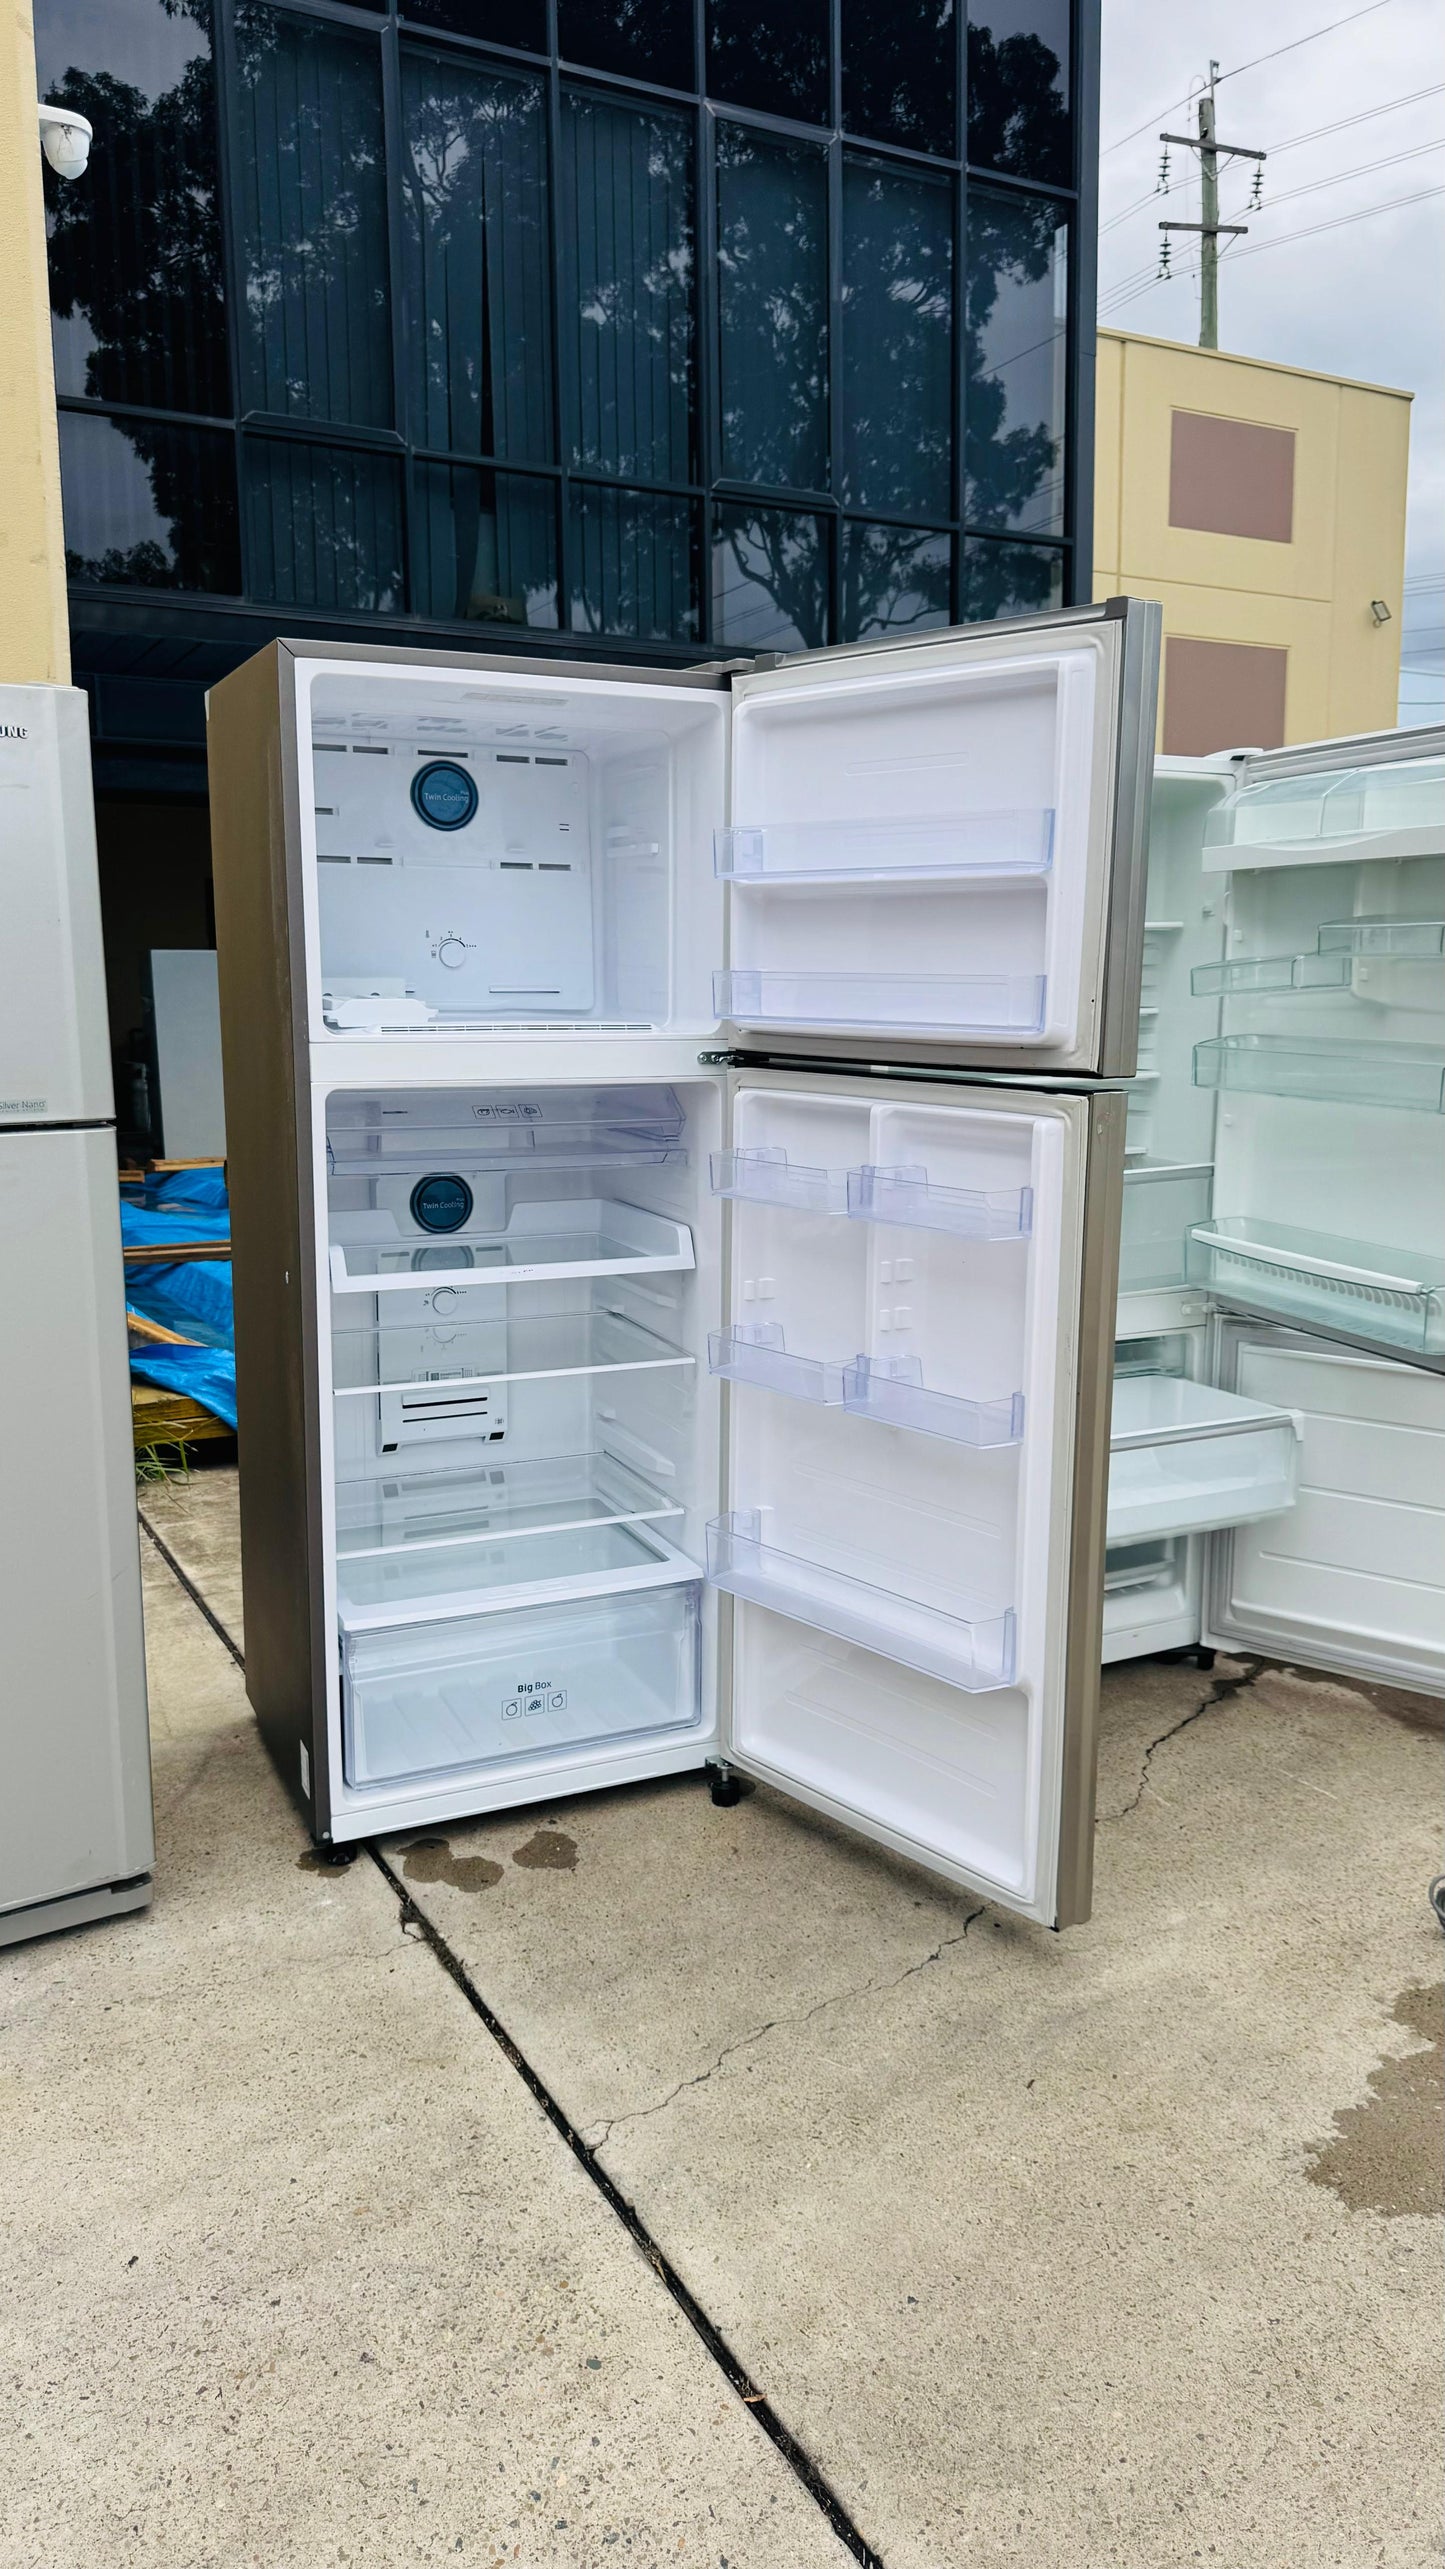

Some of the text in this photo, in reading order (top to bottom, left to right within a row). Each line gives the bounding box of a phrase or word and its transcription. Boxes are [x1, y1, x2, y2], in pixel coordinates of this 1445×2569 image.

[424, 792, 469, 804] Twin Cooling
[440, 1201, 464, 1210] Cooling
[517, 1681, 552, 1694] Big Box
